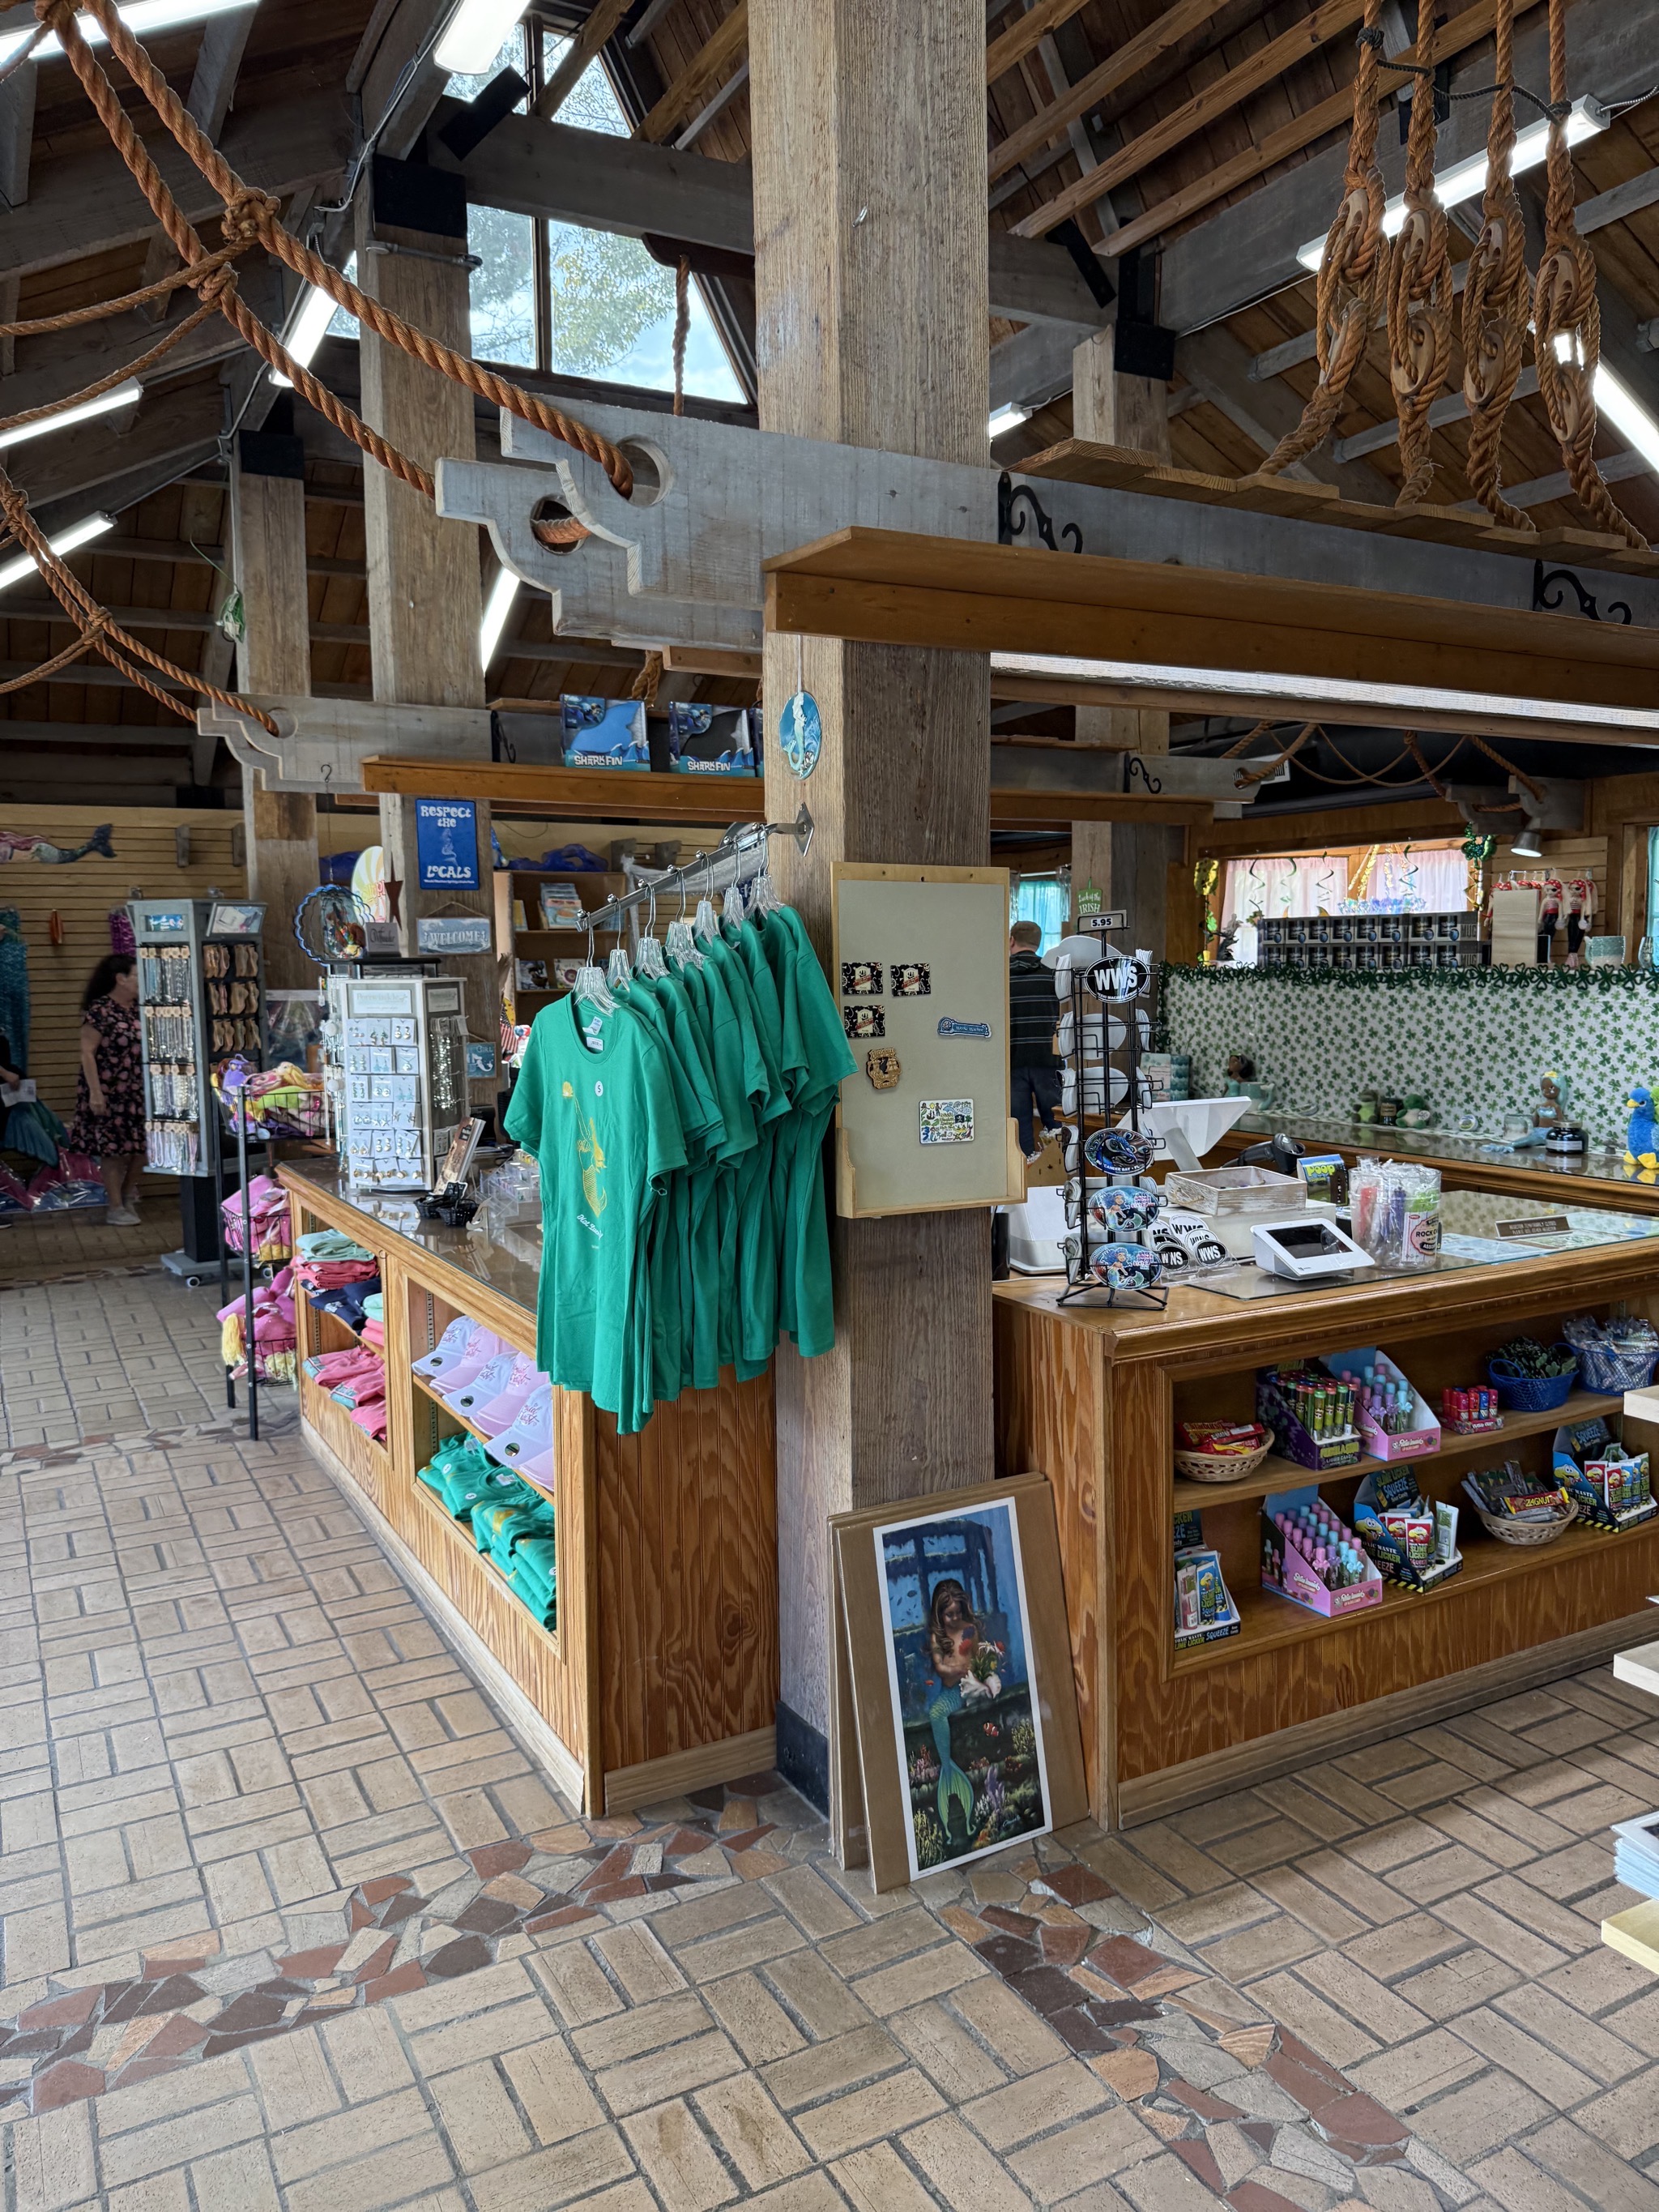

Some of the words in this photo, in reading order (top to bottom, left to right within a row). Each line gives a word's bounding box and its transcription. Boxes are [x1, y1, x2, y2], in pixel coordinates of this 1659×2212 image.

[574, 754, 605, 766] SHARK
[606, 756, 623, 766] FIN
[687, 761, 716, 771] SHARK
[715, 762, 731, 771] FIN
[1079, 903, 1100, 914] IRISH
[1092, 918, 1111, 927] 5.95
[429, 930, 481, 946] WELCOME
[1094, 966, 1137, 991] WWS
[476, 1045, 493, 1053] GIRL
[597, 1084, 601, 1093] S
[1198, 1245, 1221, 1262] WWS
[1576, 1426, 1601, 1443] SQUEEZE
[1383, 1477, 1409, 1499] SQUEEZE
[1575, 1488, 1593, 1498] WASTE
[1525, 1496, 1550, 1507] ZAGNUT
[1576, 1493, 1597, 1507] LICKER
[1377, 1544, 1397, 1554] WASTE
[1377, 1550, 1401, 1564] LICKER
[1206, 1626, 1230, 1641] SQUEEZE
[1175, 1641, 1187, 1650] LIME
[1188, 1637, 1205, 1647] LICKER
